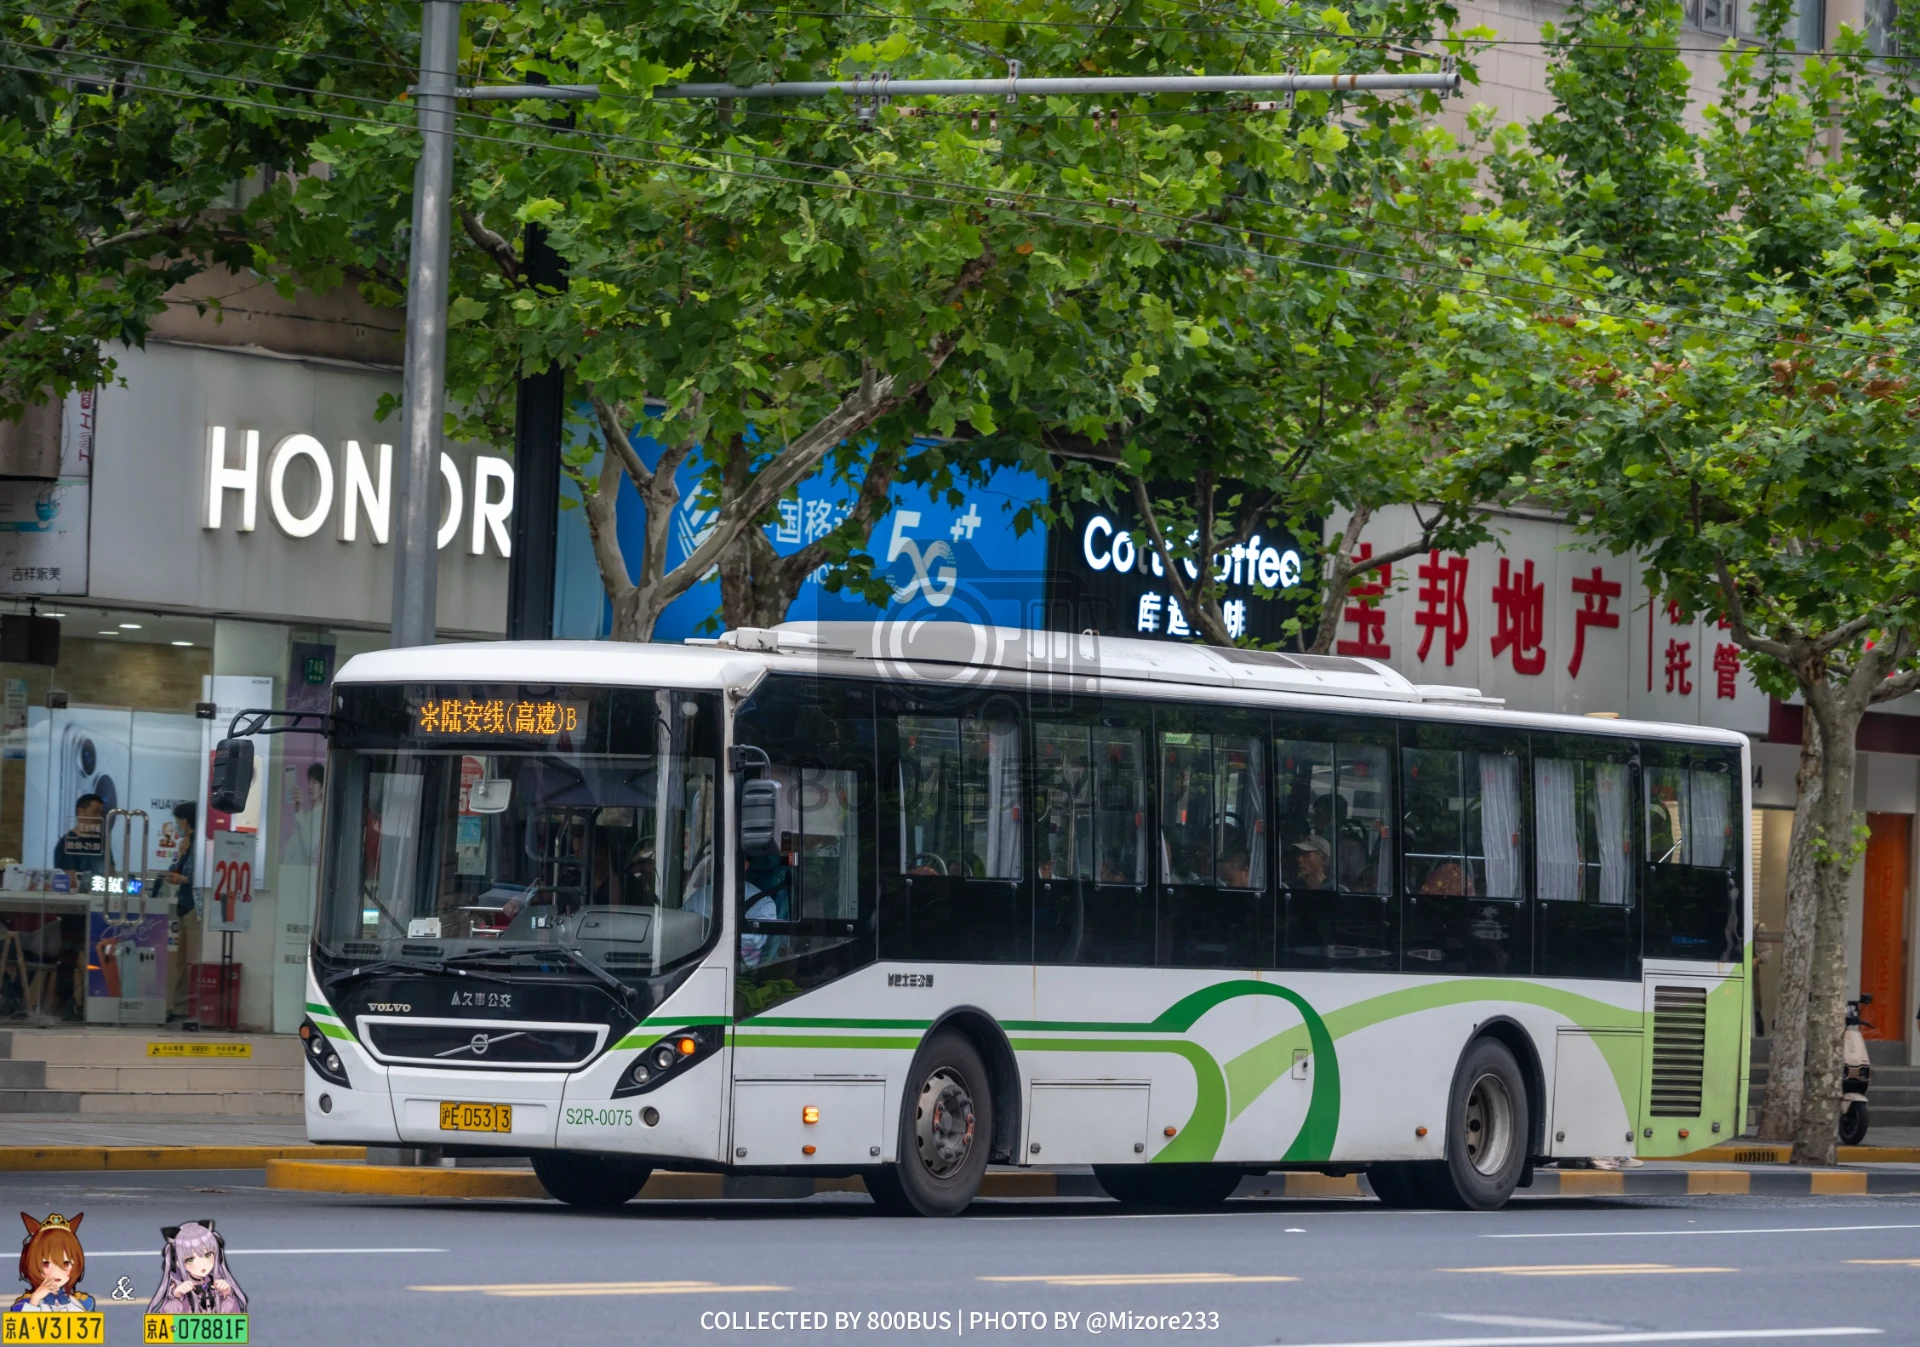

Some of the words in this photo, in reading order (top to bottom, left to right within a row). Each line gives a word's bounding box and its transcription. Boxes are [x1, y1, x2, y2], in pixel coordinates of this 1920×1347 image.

[1137, 592, 1246, 639] 库迪啡
[1337, 542, 1622, 679] 宝邦地产
[1665, 639, 1741, 699] 托管
[367, 1002, 412, 1012] VOLVO
[461, 991, 512, 1008] 久事公交
[566, 1109, 633, 1126] S2R-0075
